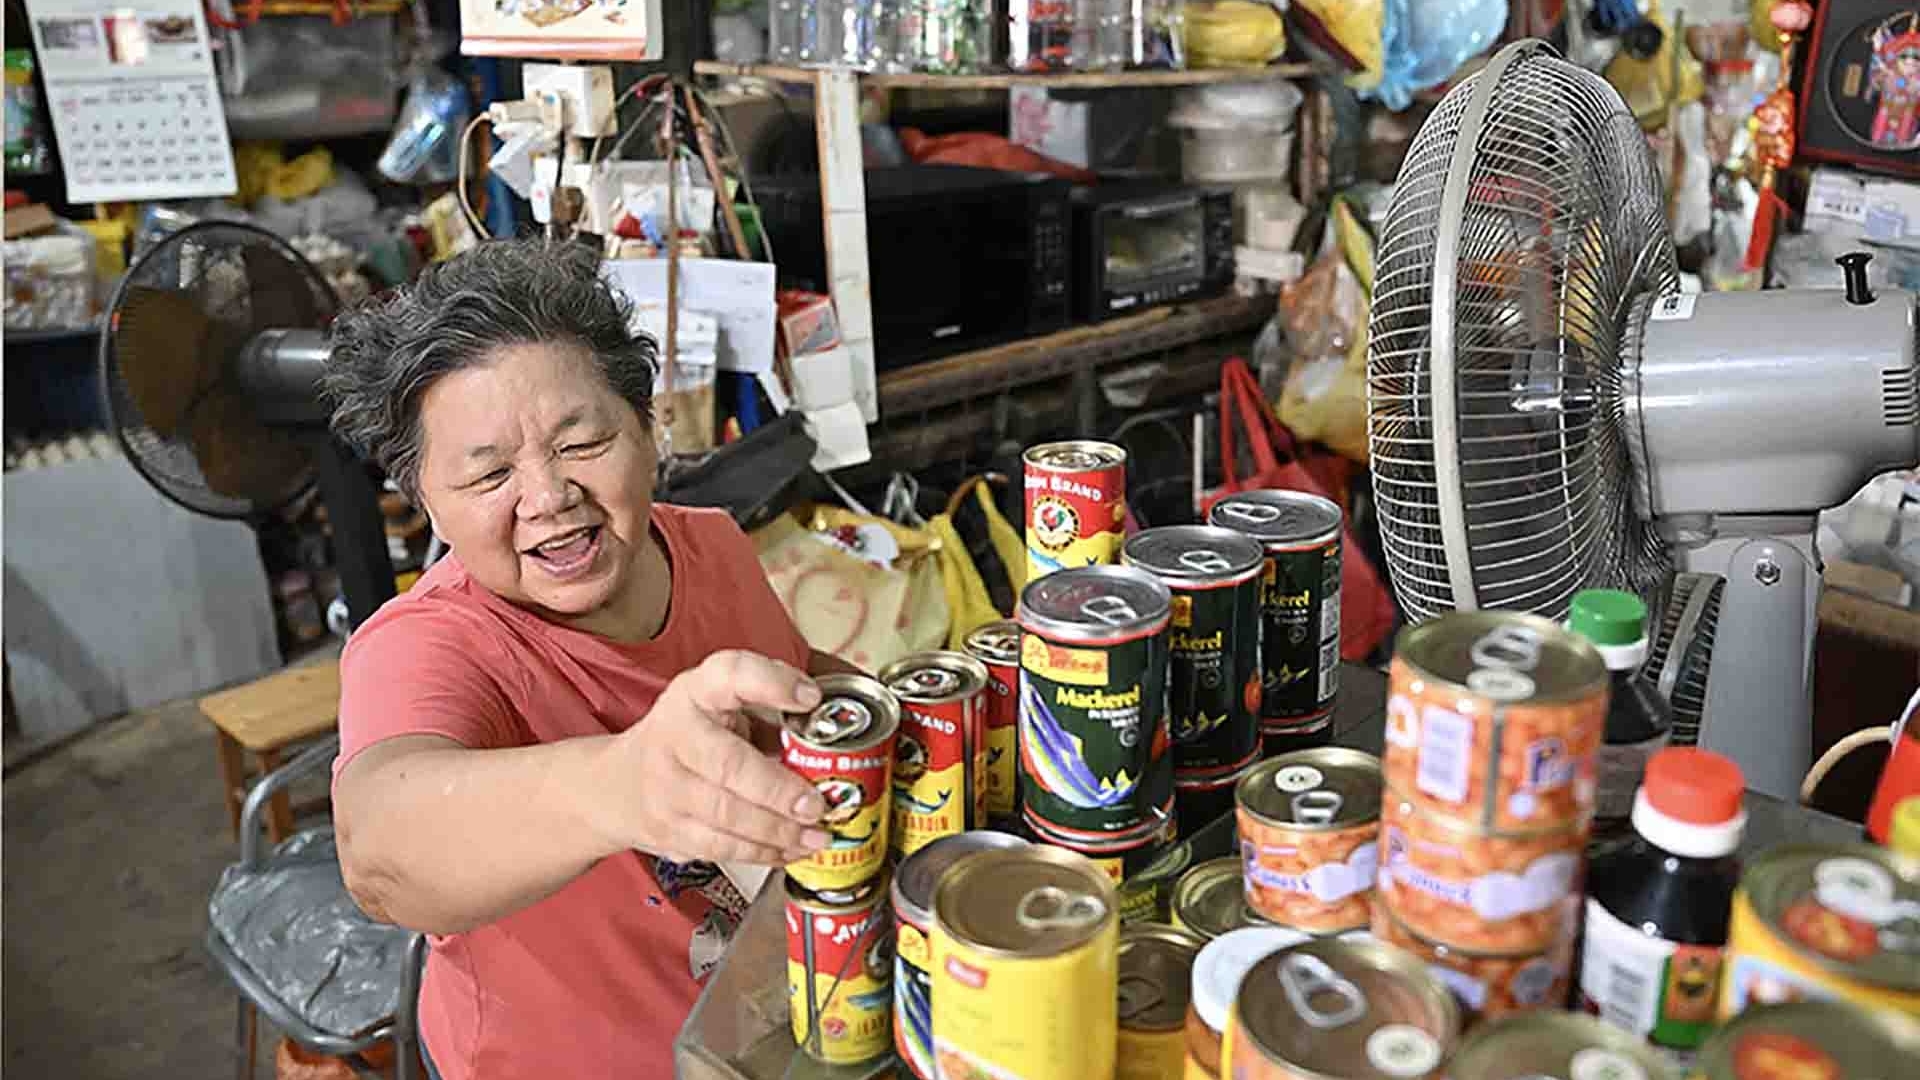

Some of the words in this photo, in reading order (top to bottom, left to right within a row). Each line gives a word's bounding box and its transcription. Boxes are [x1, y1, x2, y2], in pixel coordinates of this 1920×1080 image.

[1050, 476, 1102, 502] BRAND
[1056, 684, 1141, 710] Mackerel
[787, 748, 833, 771] AYAM
